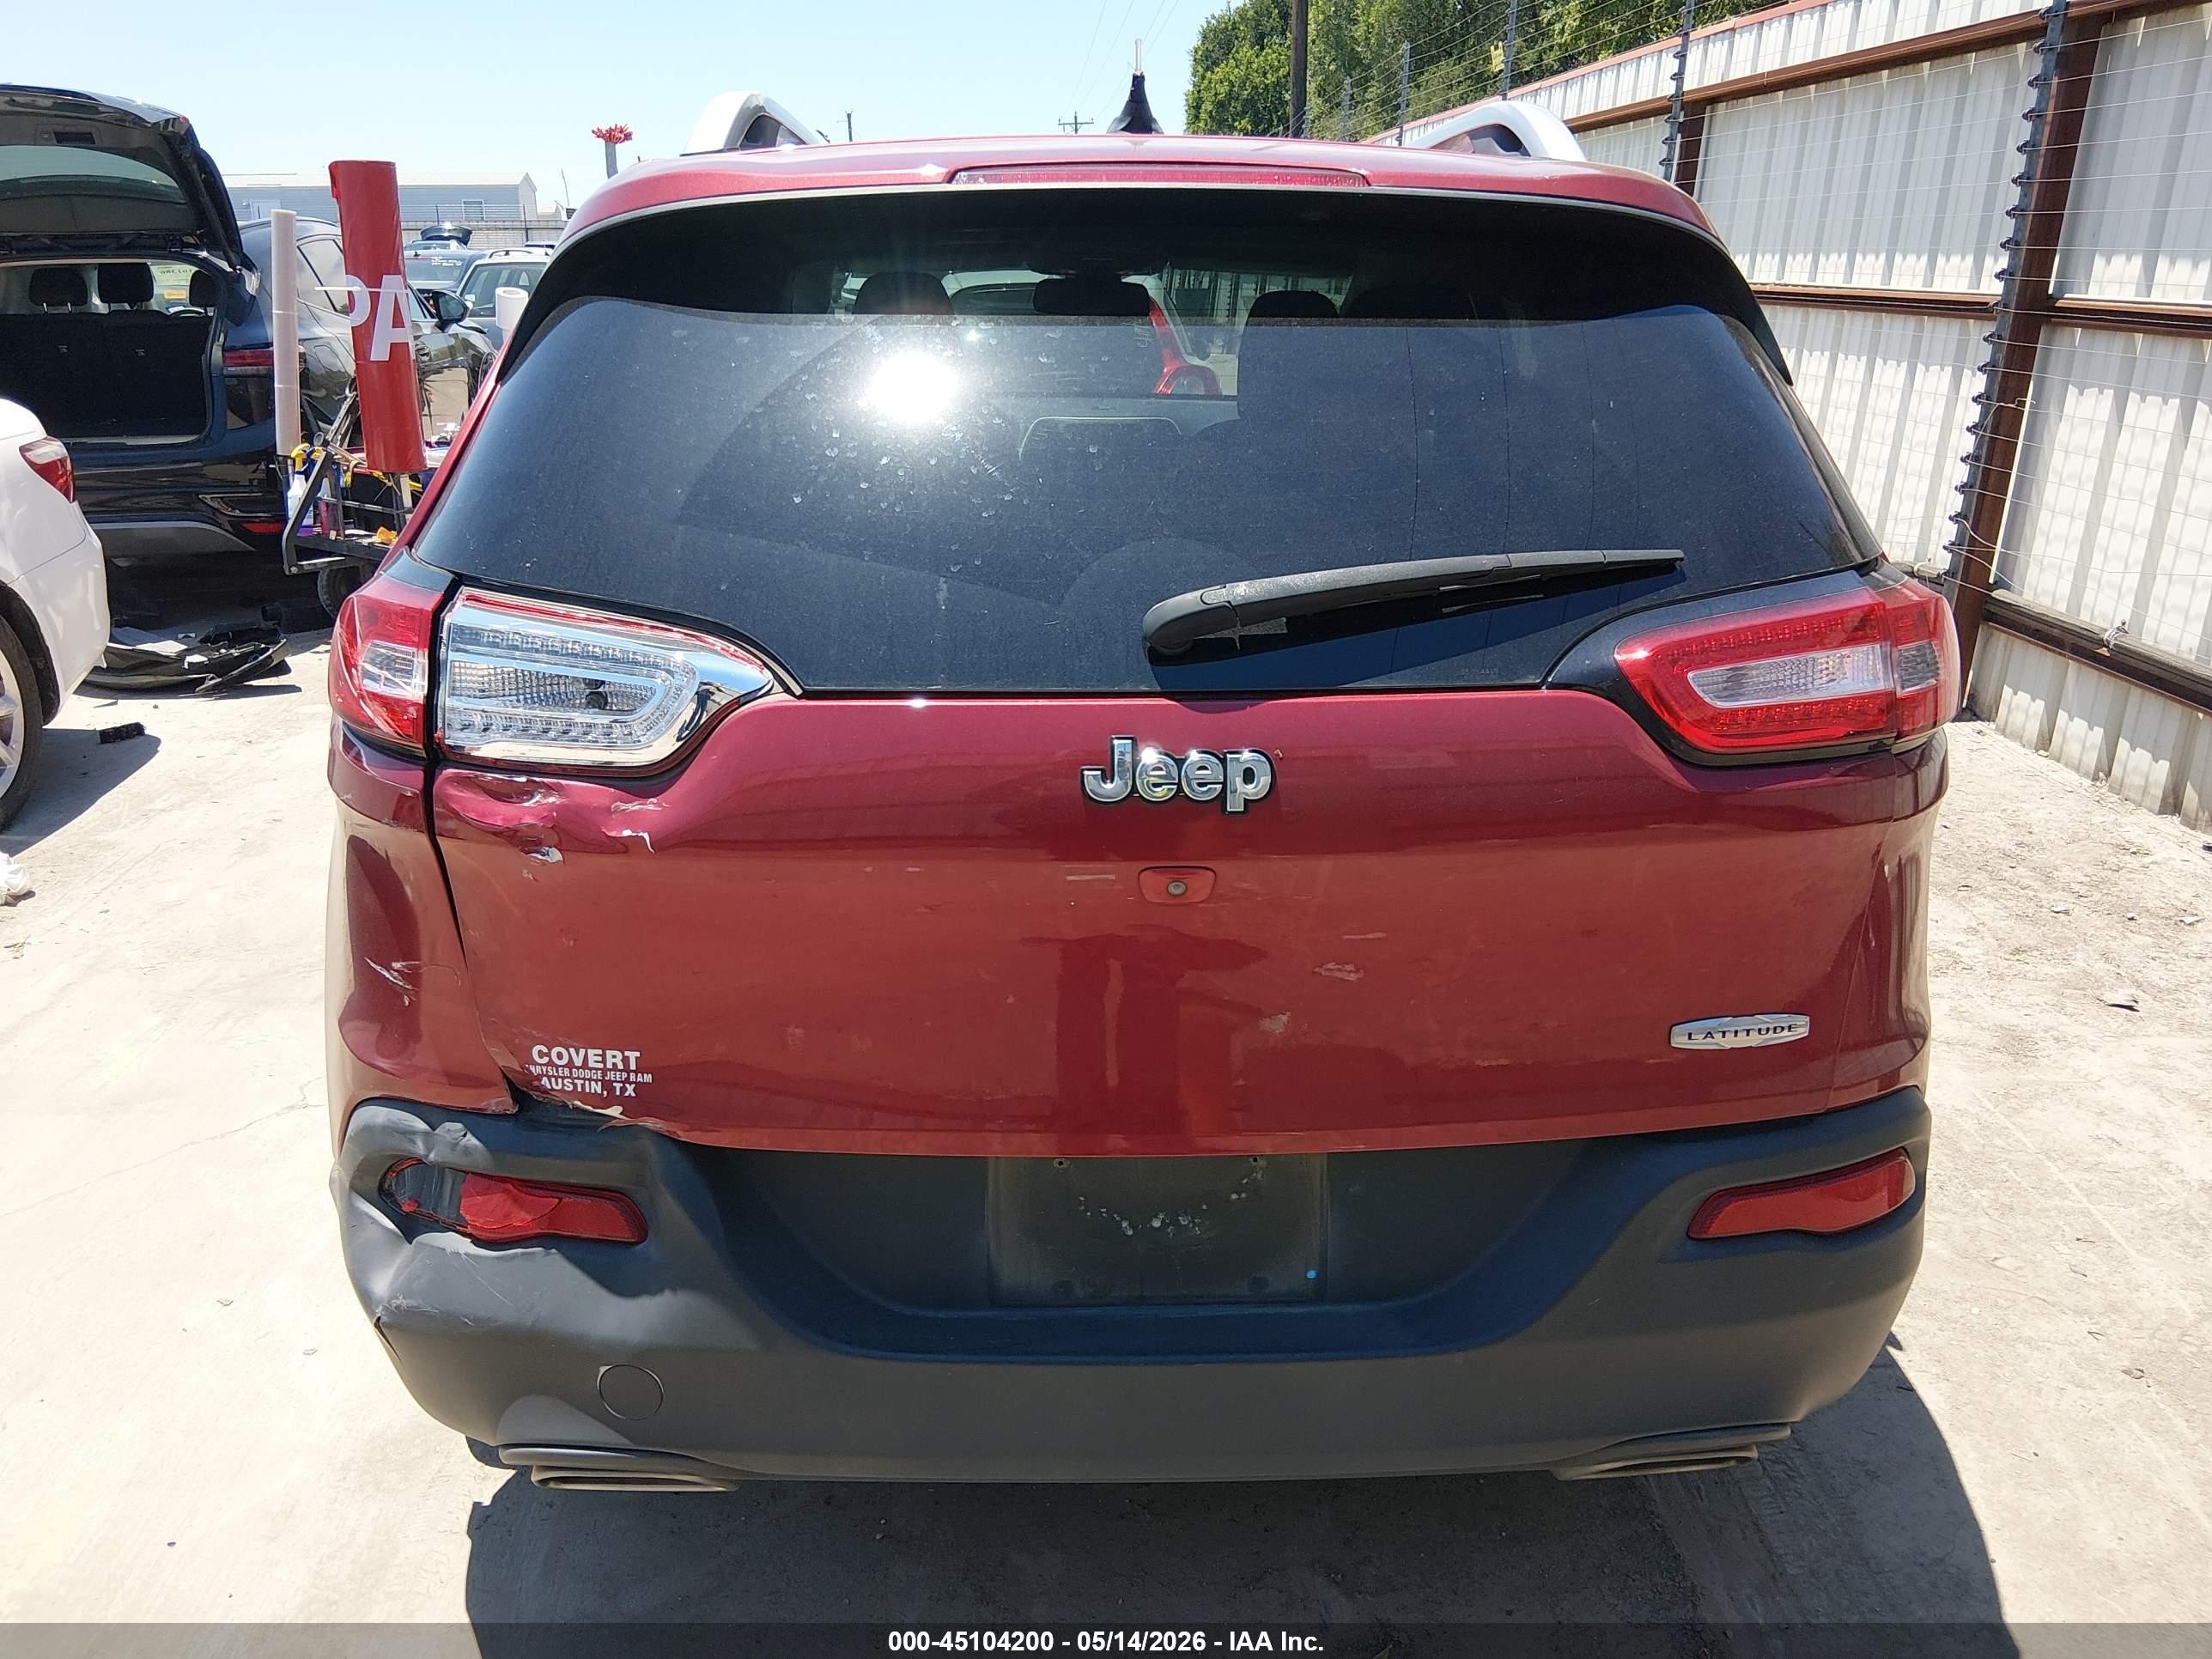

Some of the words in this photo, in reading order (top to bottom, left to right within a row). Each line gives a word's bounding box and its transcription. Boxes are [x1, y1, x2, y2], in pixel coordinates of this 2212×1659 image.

[1082, 736, 1275, 813] Jeep
[1687, 1024, 1798, 1041] LATITUDE
[532, 1044, 641, 1071] COVERT
[572, 1066, 603, 1079] DODGE
[605, 1071, 627, 1081] JEEP
[629, 1073, 653, 1083] RAM
[541, 1076, 608, 1097] AUSTIN,
[613, 1083, 636, 1097] TX
